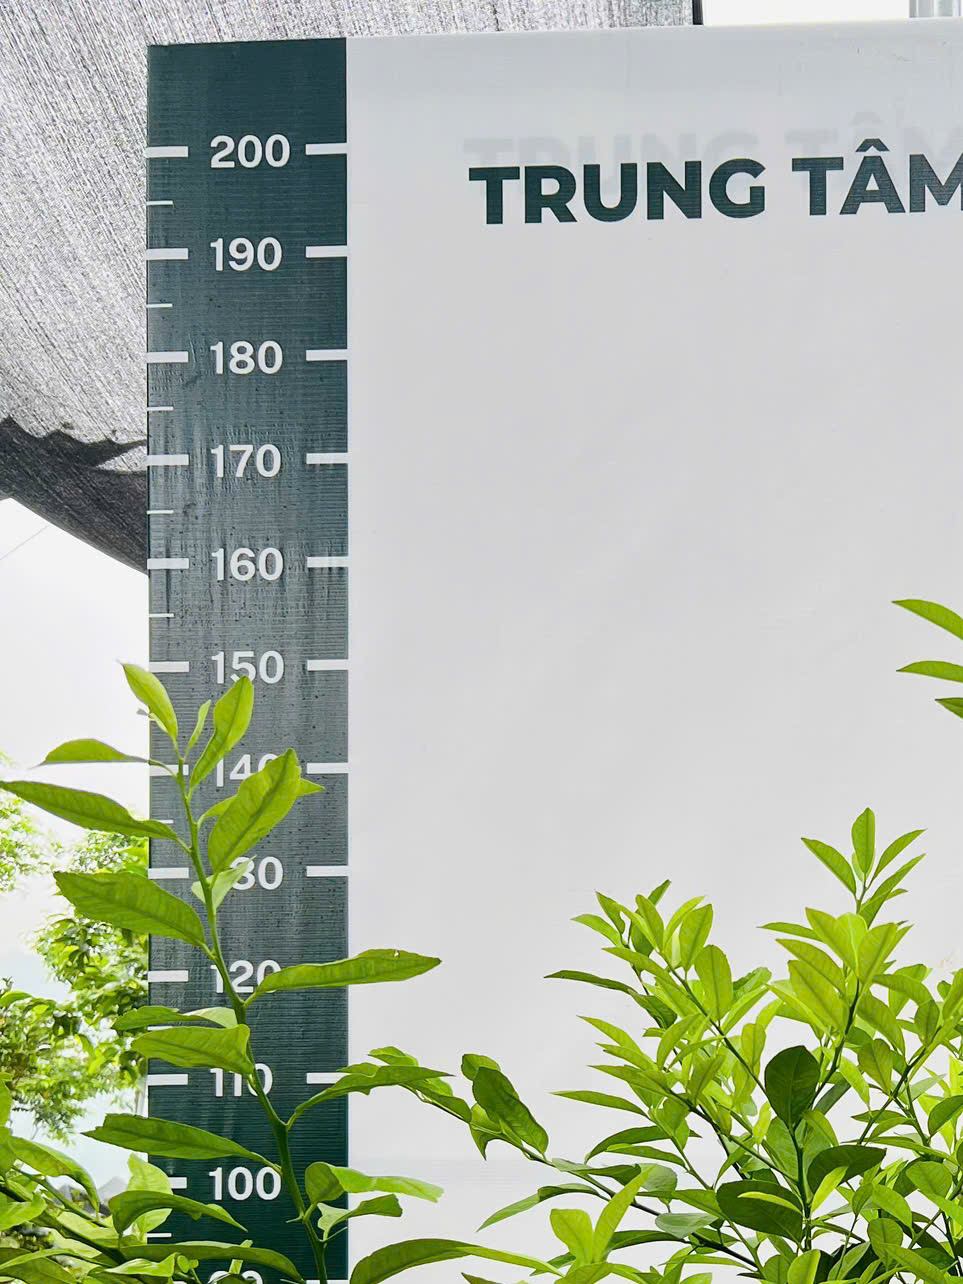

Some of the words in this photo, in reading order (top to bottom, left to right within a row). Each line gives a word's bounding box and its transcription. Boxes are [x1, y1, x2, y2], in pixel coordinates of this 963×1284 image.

[210, 134, 290, 168] 200
[468, 158, 766, 225] TRUNG
[210, 237, 282, 271] 190
[210, 340, 283, 375] 180
[210, 443, 281, 478] 170
[211, 547, 283, 581] 160
[211, 650, 284, 684] 150
[229, 856, 283, 890] 30
[208, 1166, 282, 1201] 100
